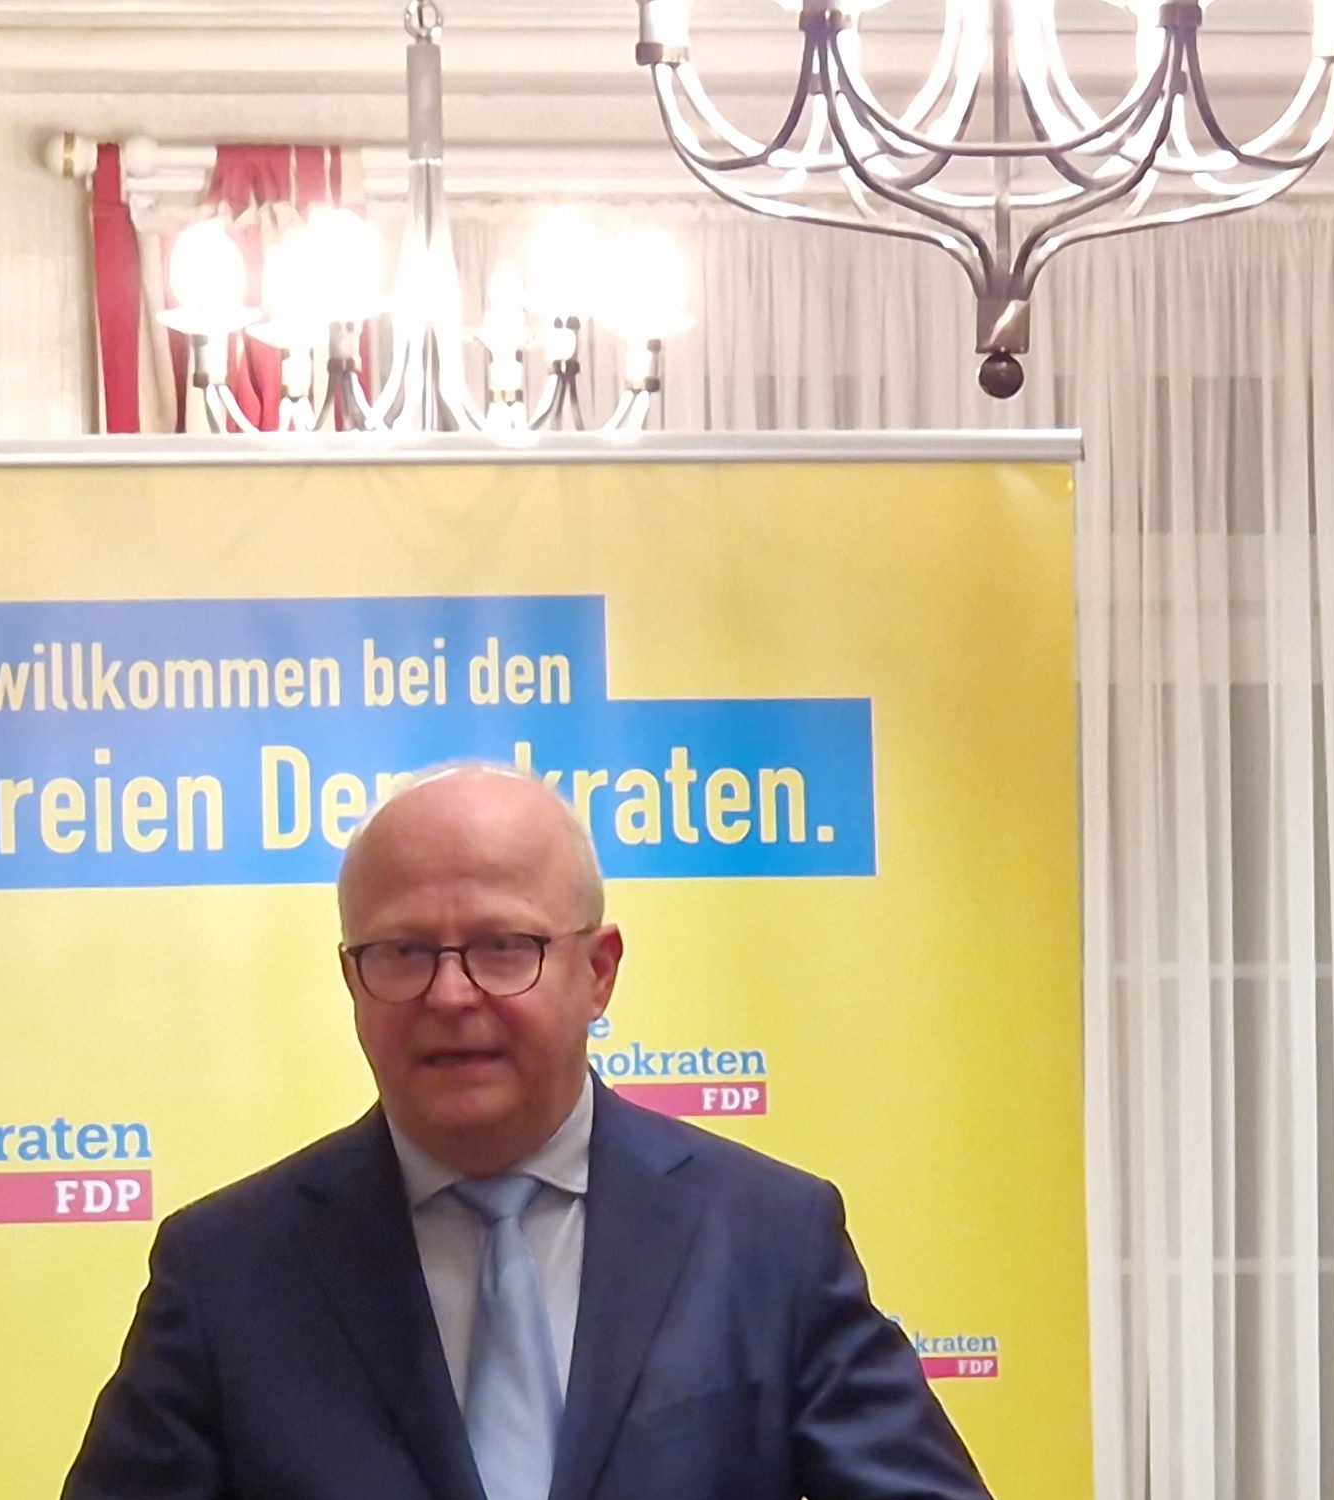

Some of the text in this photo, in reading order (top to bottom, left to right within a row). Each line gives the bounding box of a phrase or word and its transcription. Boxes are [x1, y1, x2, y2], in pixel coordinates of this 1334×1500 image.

[363, 638, 447, 706] bei
[469, 637, 571, 704] den
[261, 741, 835, 849] Deraten.
[588, 1043, 767, 1076] okraten
[701, 1087, 760, 1111] FDP
[55, 1180, 141, 1213] FDP
[914, 1331, 997, 1354] kraten
[957, 1359, 994, 1375] FDP
